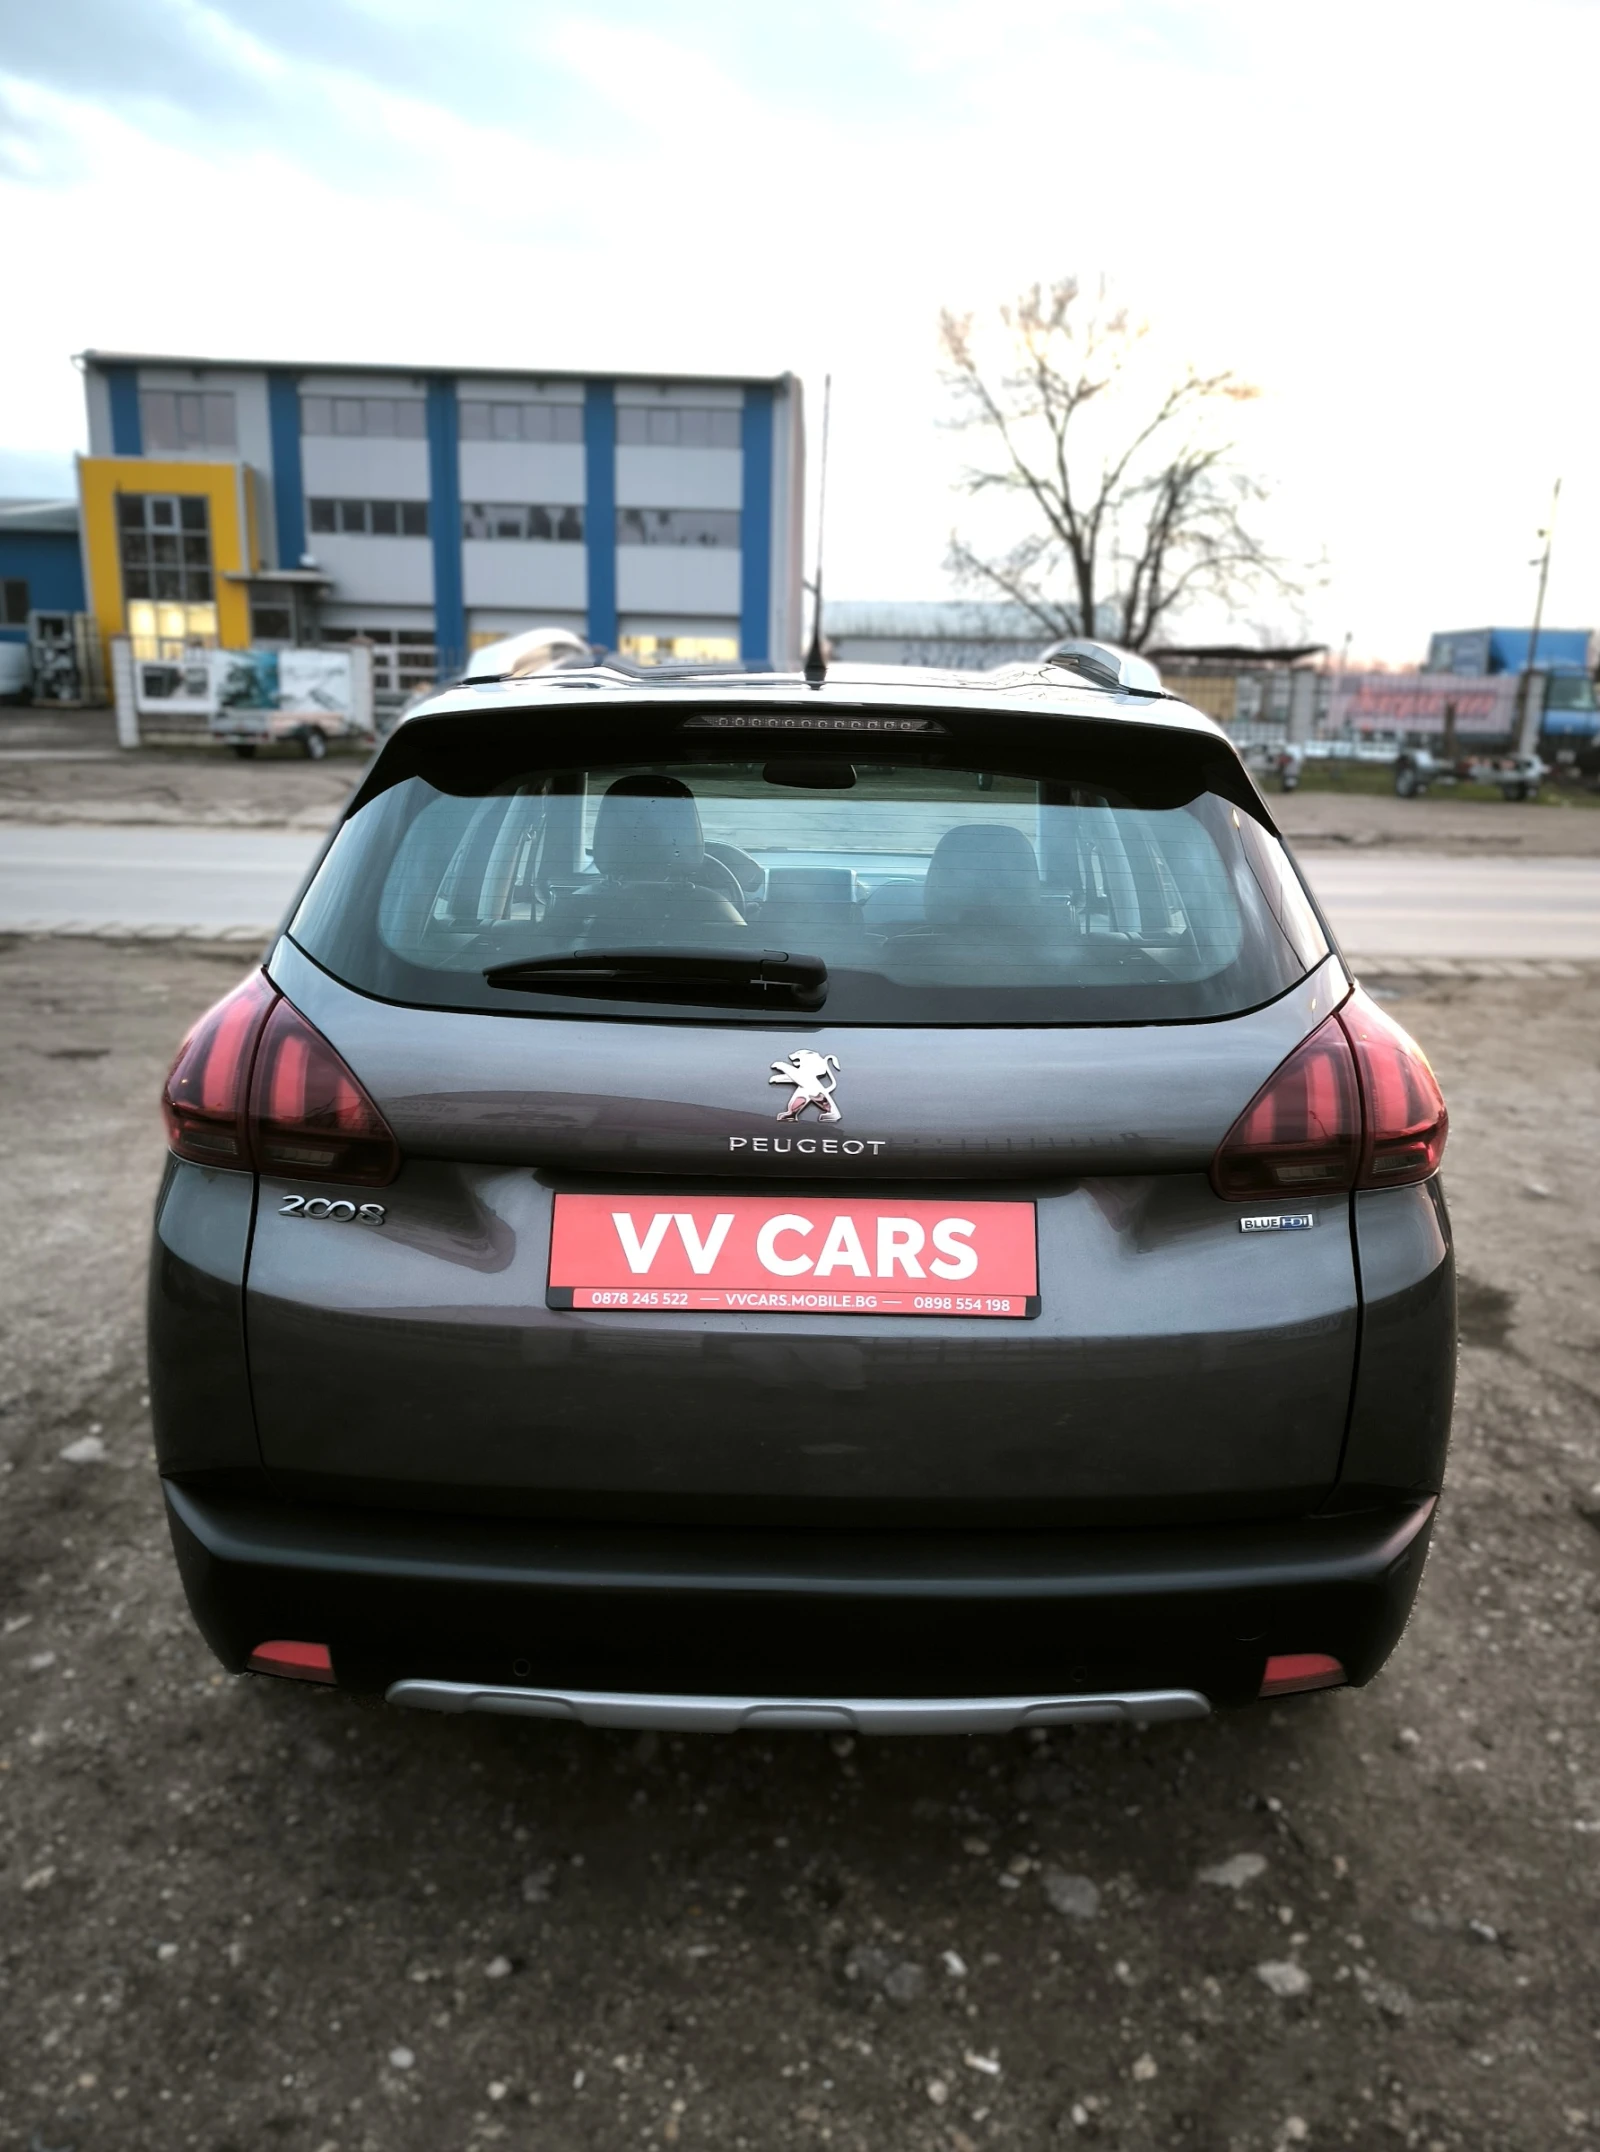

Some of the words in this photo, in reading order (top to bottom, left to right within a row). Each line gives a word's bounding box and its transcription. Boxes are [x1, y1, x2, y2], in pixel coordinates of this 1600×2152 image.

[729, 1136, 886, 1155] PEUGEOT
[278, 1194, 385, 1226] 2008
[611, 1212, 735, 1275] VV
[756, 1213, 979, 1281] CARS
[591, 1291, 629, 1305] 0878
[631, 1292, 659, 1305] 245
[662, 1292, 689, 1306] 522
[725, 1293, 878, 1308] VVCARS.MOBILE.BG
[913, 1296, 952, 1310] 0898
[955, 1297, 982, 1311] 554
[985, 1299, 1011, 1312] 198
